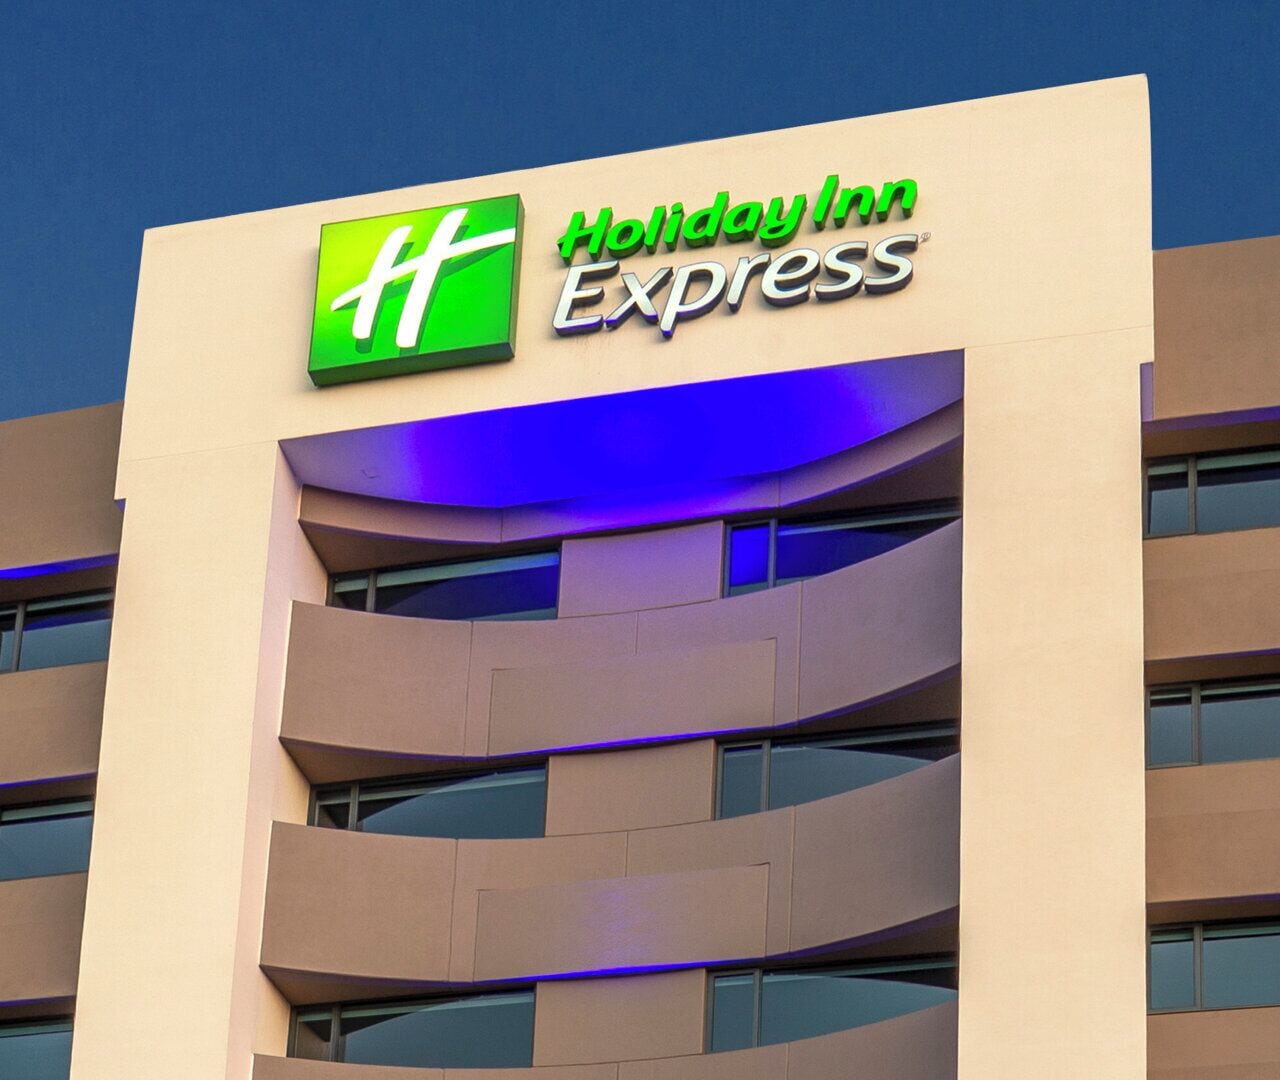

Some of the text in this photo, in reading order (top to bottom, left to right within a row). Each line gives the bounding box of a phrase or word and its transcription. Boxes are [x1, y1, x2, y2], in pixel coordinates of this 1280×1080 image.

[557, 174, 918, 263] Holiday Inn
[552, 234, 920, 339] Express
